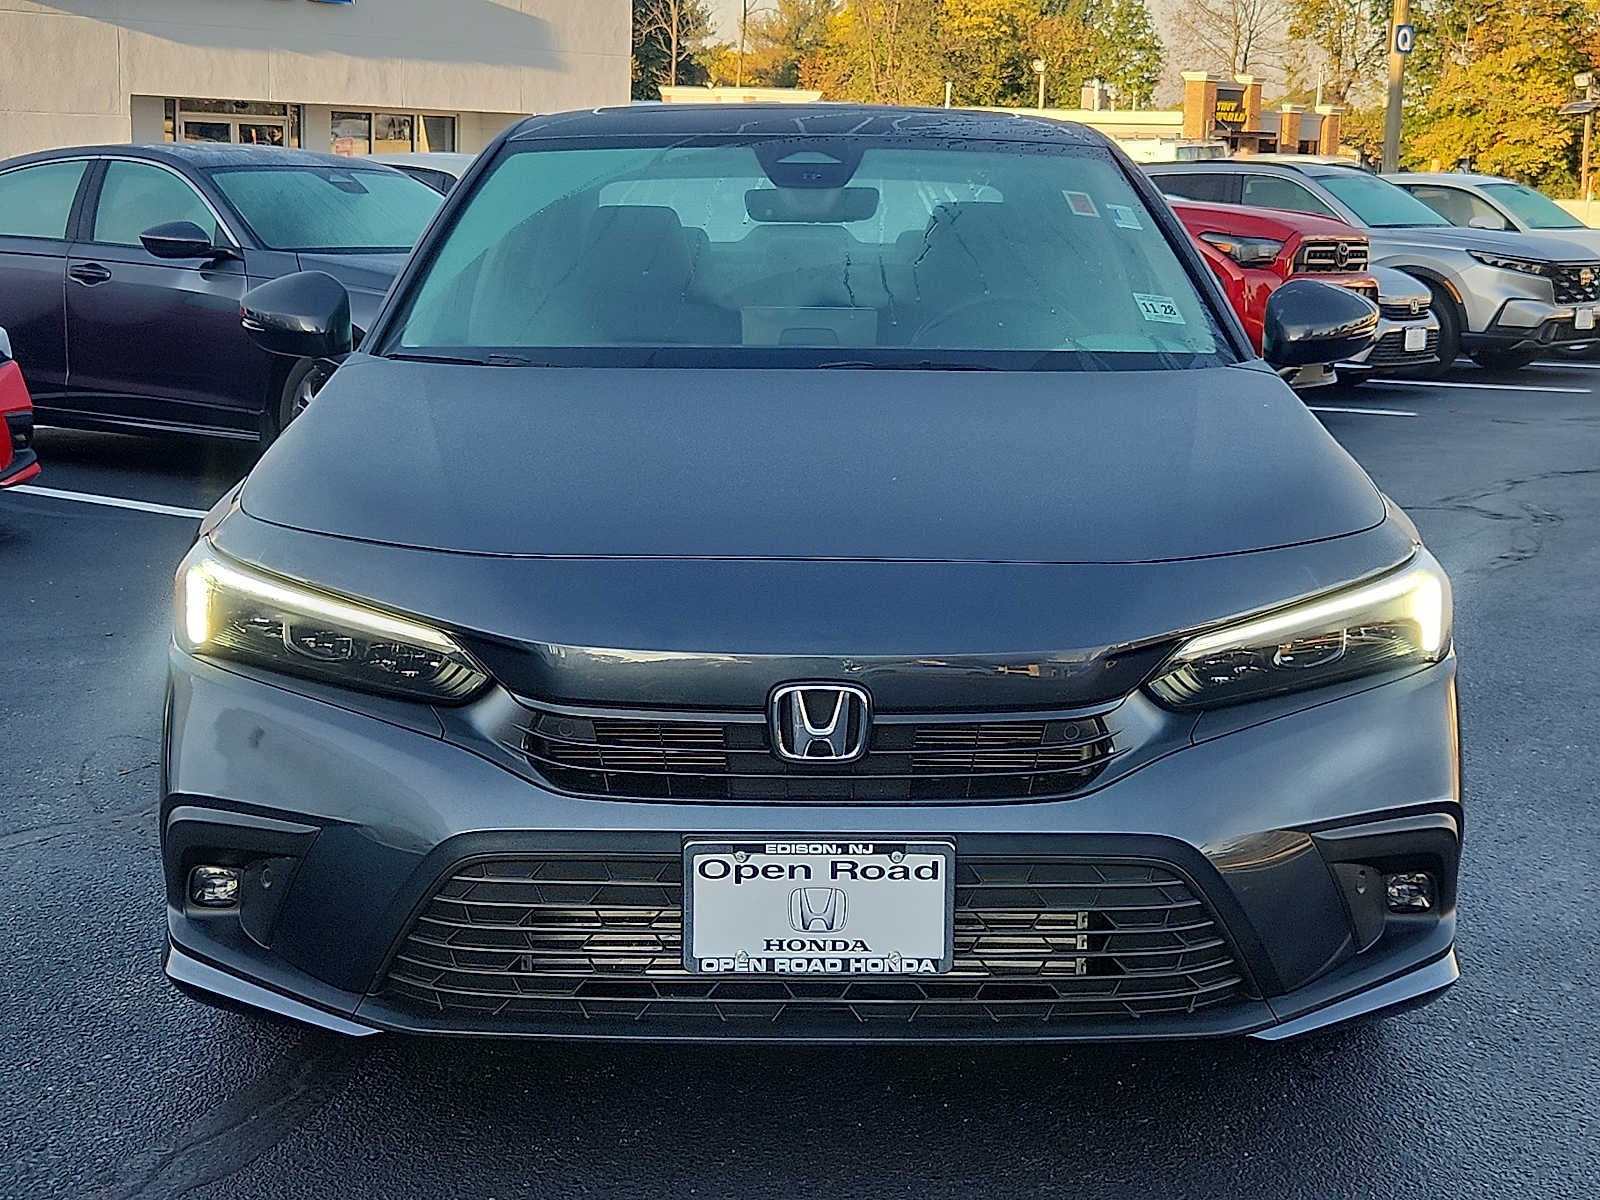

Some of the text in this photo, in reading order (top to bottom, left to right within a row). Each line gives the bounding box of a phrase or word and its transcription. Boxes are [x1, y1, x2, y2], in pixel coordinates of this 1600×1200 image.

[1398, 28, 1411, 51] Q
[1141, 302, 1177, 316] 11 28
[765, 843, 874, 855] EDISON, NJ
[698, 859, 940, 885] Open Road
[763, 938, 873, 952] HONDA
[701, 958, 937, 973] OPEN ROAD HONDA
